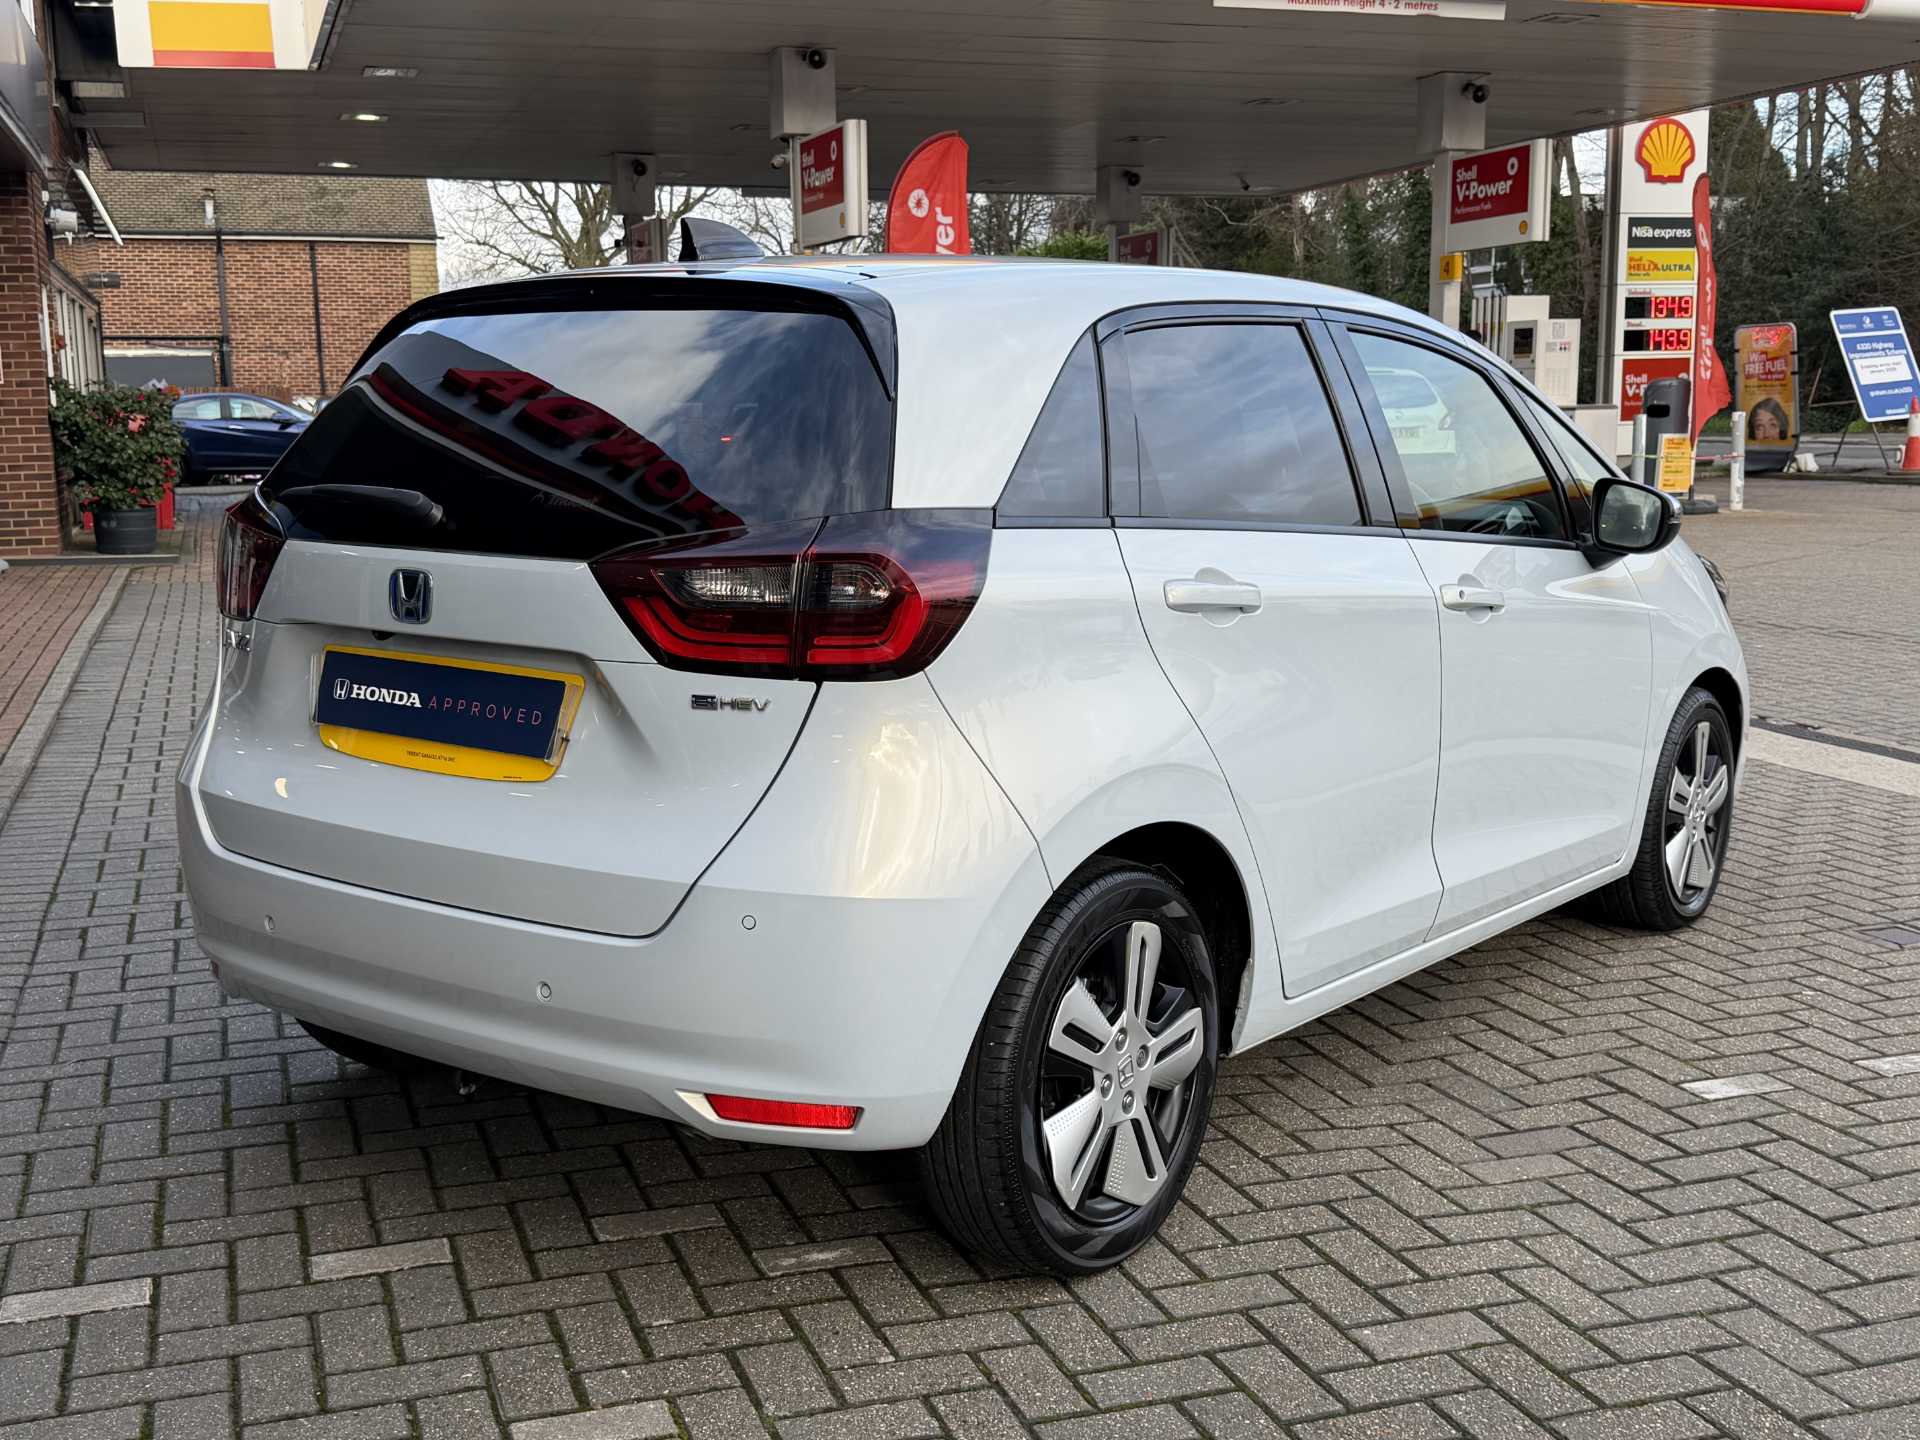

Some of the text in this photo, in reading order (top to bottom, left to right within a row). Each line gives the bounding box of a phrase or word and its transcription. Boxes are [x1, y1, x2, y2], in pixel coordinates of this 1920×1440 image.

[1404, 2, 1439, 11] metres
[803, 166, 834, 189] V-Power
[1456, 164, 1478, 182] Shell
[1456, 179, 1513, 202] V-Power
[1443, 261, 1450, 275] 4
[1628, 263, 1658, 272] HELIX
[1650, 296, 1692, 318] 134.9
[1648, 329, 1691, 351] 143.9
[1744, 358, 1786, 376] FREE FUEL
[1625, 373, 1648, 384] Shell
[351, 683, 542, 725] HONDA APPROVED
